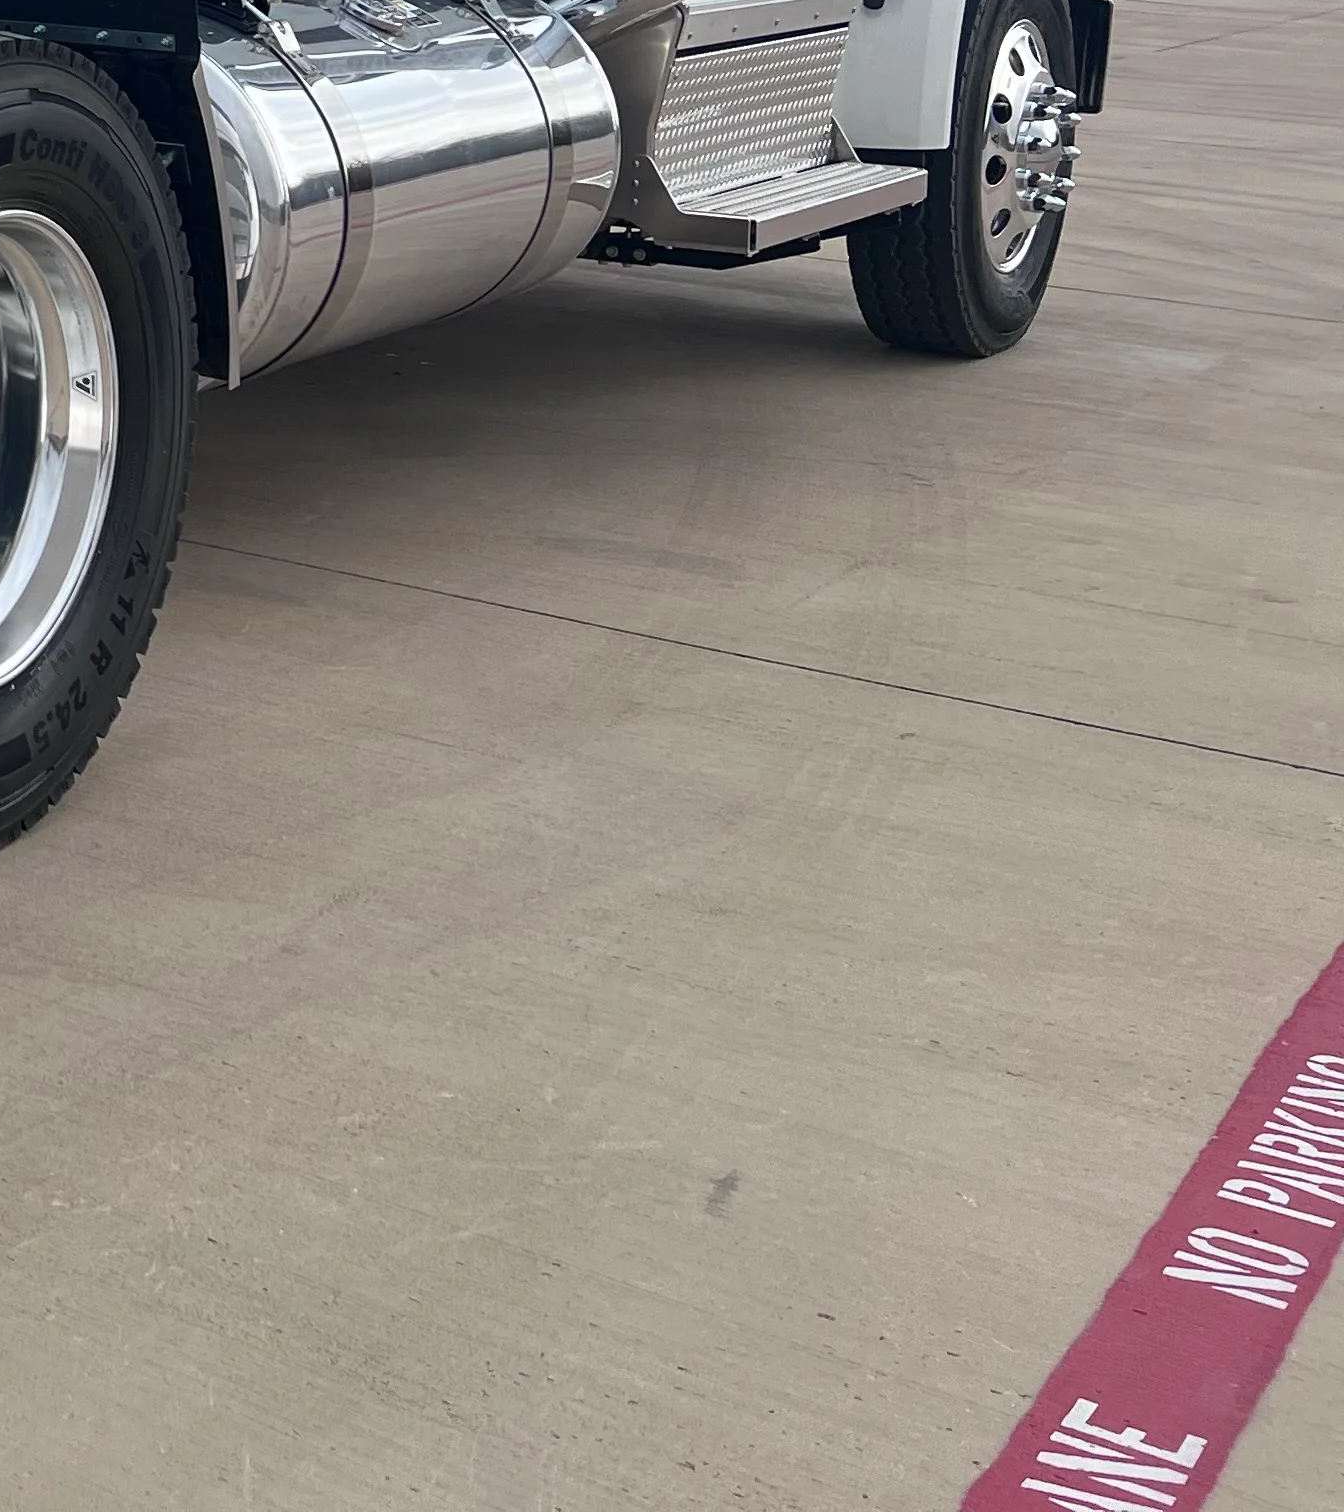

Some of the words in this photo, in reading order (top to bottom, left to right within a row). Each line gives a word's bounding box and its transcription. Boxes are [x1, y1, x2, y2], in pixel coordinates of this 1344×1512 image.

[19, 129, 87, 172] Conti
[109, 594, 134, 636] 11
[89, 638, 114, 676] R
[32, 676, 88, 755] 24.5
[1162, 1226, 1309, 1310] NO
